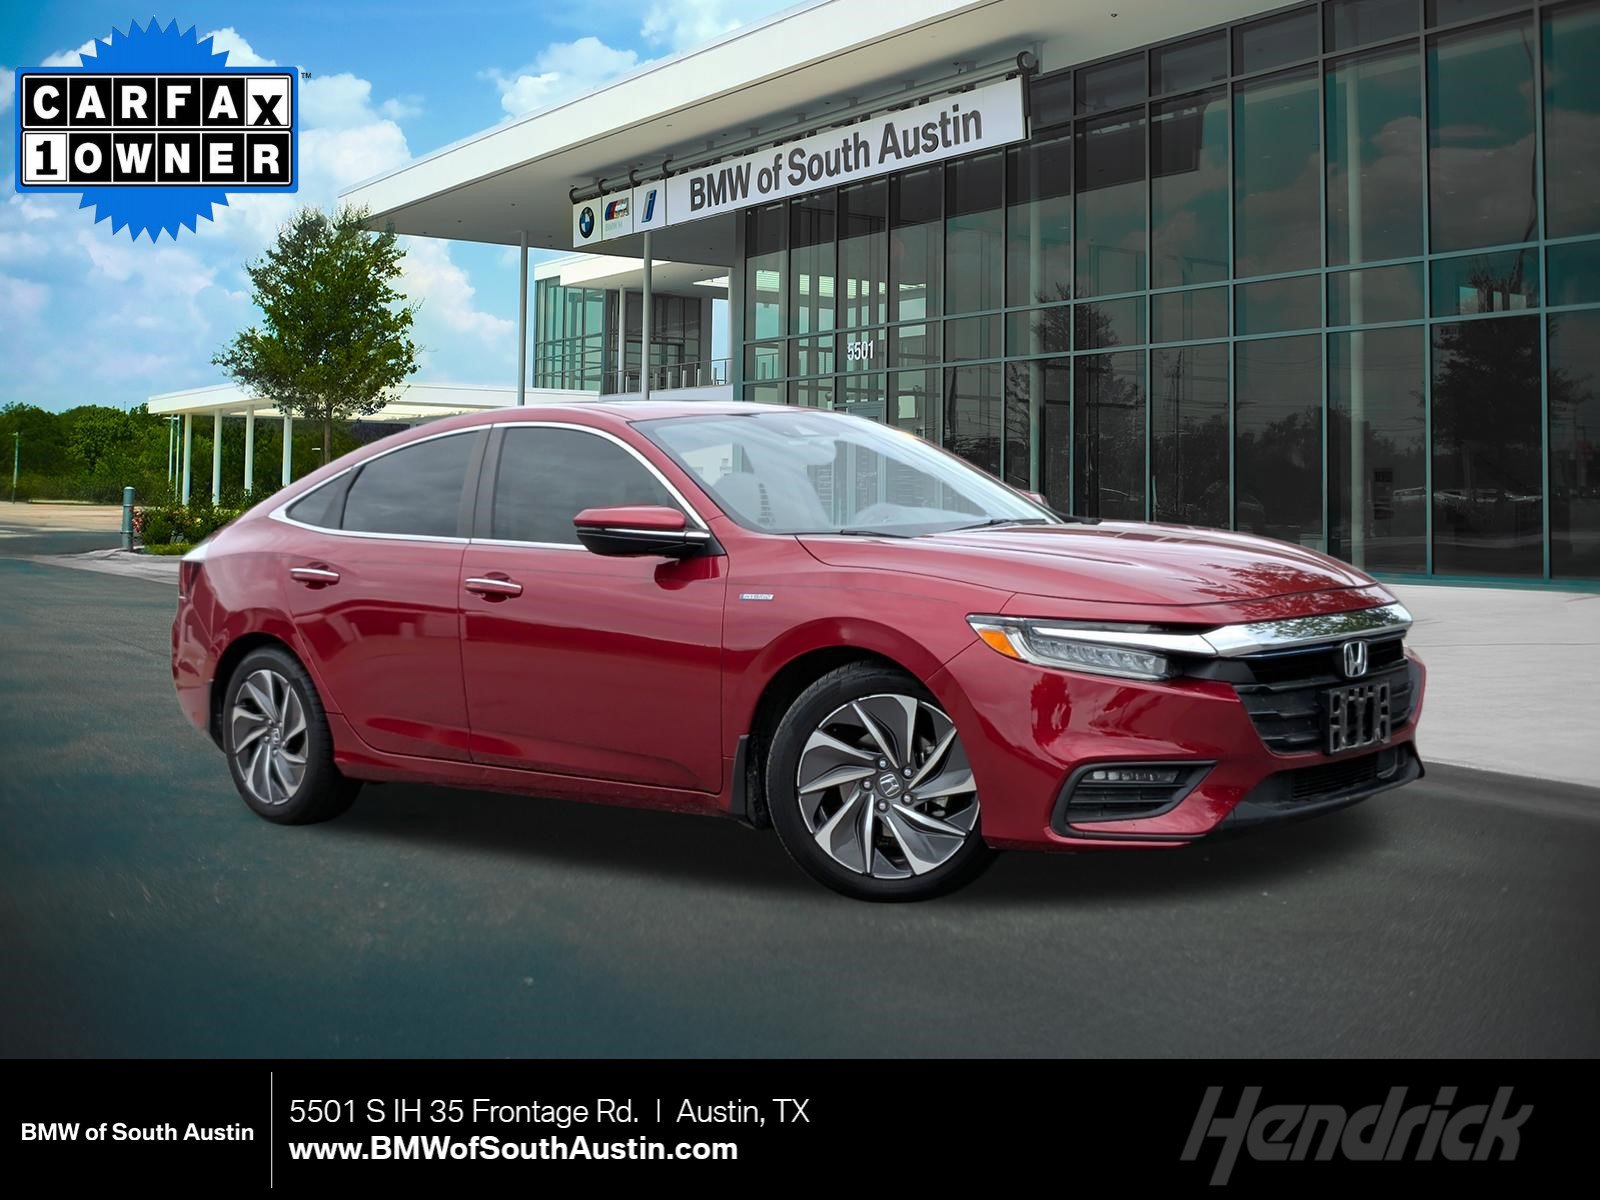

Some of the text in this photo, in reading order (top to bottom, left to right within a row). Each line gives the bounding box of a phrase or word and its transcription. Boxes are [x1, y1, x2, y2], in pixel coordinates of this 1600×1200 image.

[689, 103, 983, 213] BMW of South Austin
[847, 340, 874, 361] 5501
